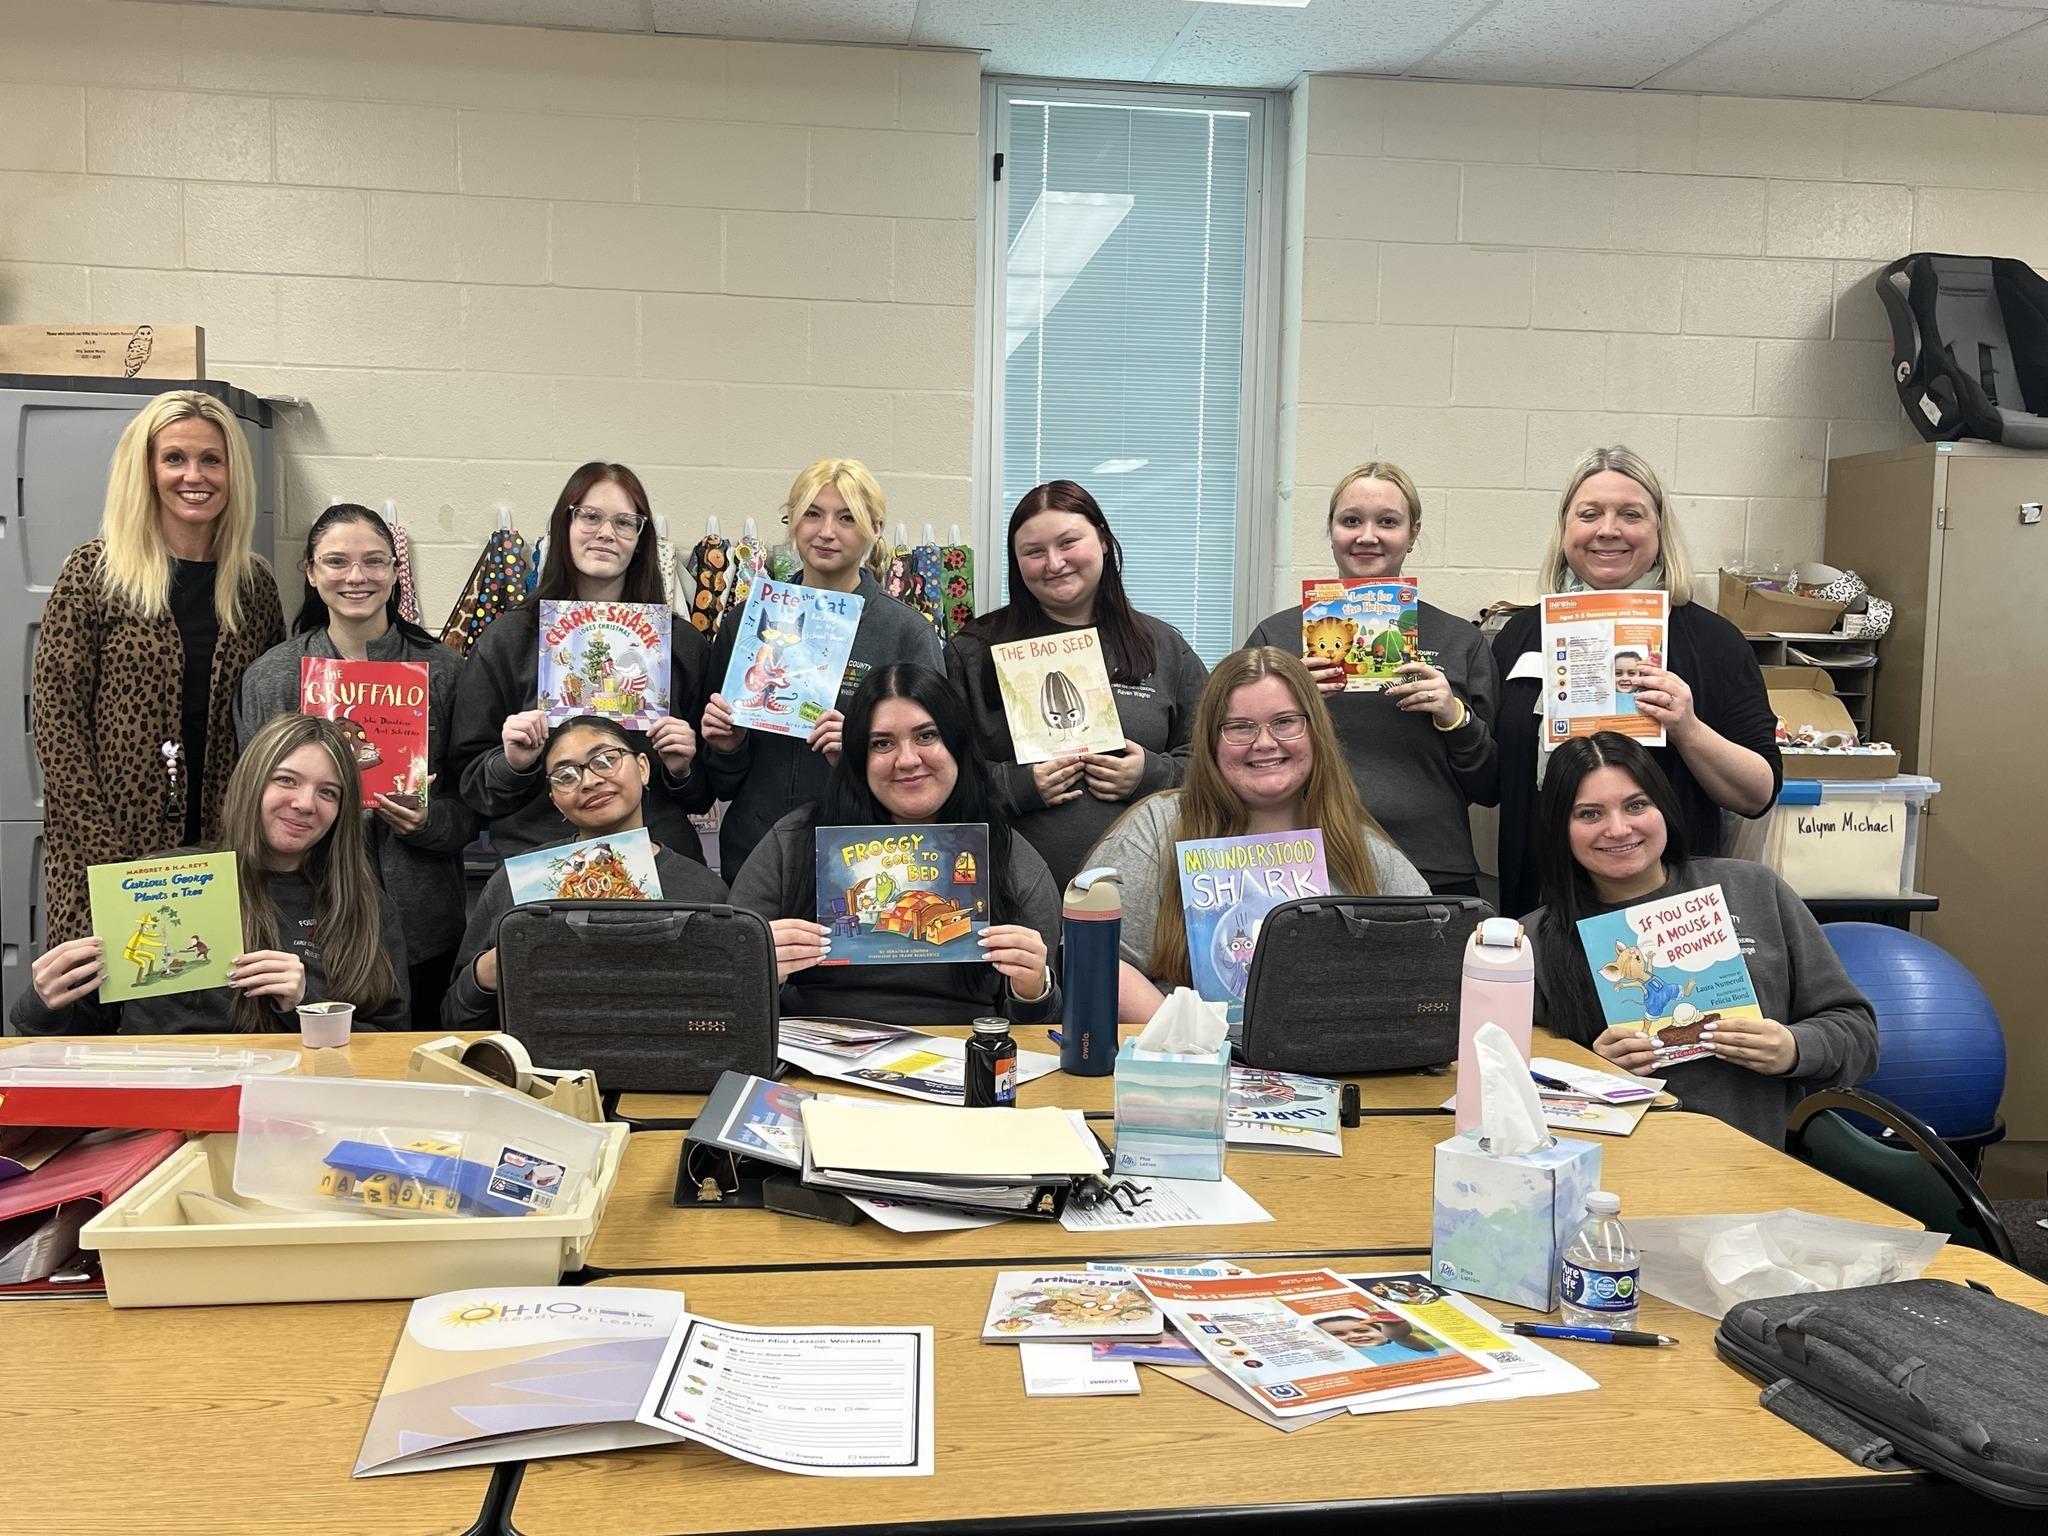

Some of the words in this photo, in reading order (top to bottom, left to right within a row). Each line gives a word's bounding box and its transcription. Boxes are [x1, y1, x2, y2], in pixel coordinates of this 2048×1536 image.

[760, 583, 800, 607] Pete
[802, 593, 816, 601] the
[1362, 602, 1400, 615] Helpers
[546, 607, 597, 646] CLARK
[606, 606, 662, 649] SHARK
[998, 646, 1025, 662] THE
[1030, 641, 1057, 658] BAD
[1063, 634, 1094, 654] SEED
[849, 660, 872, 672] COUNTY
[306, 681, 424, 706] GRUFFALO
[1798, 817, 1836, 839] Kalynn
[1842, 811, 1894, 833] Michael
[841, 833, 924, 868] FROGGY
[882, 852, 916, 868] GOES
[922, 851, 939, 861] TO
[1184, 839, 1316, 875] MISUNDERSTOOD
[122, 878, 167, 890] Curious
[172, 872, 214, 886] George
[126, 866, 162, 875] MARGRET
[907, 865, 940, 882] BED
[134, 890, 168, 902] Plants
[171, 891, 178, 899] a
[181, 887, 203, 897] Tree
[574, 875, 613, 899] TOO
[1192, 868, 1322, 910] SHARK
[1639, 915, 1653, 933] IF
[1655, 906, 1682, 925] YOU
[1684, 892, 1720, 914] GIVE
[1656, 932, 1665, 947] A
[1667, 915, 1711, 941] MOUSE
[1713, 911, 1722, 925] A
[1666, 929, 1728, 963] BROWNIE
[1696, 983, 1715, 993] Laura
[1711, 997, 1731, 1006] Felicia
[1732, 992, 1750, 1001] Bond
[1082, 1032, 1090, 1060] owala
[1032, 1276, 1096, 1286] Arthur's
[1562, 1273, 1576, 1289] Life
[459, 1302, 582, 1321] OHIO
